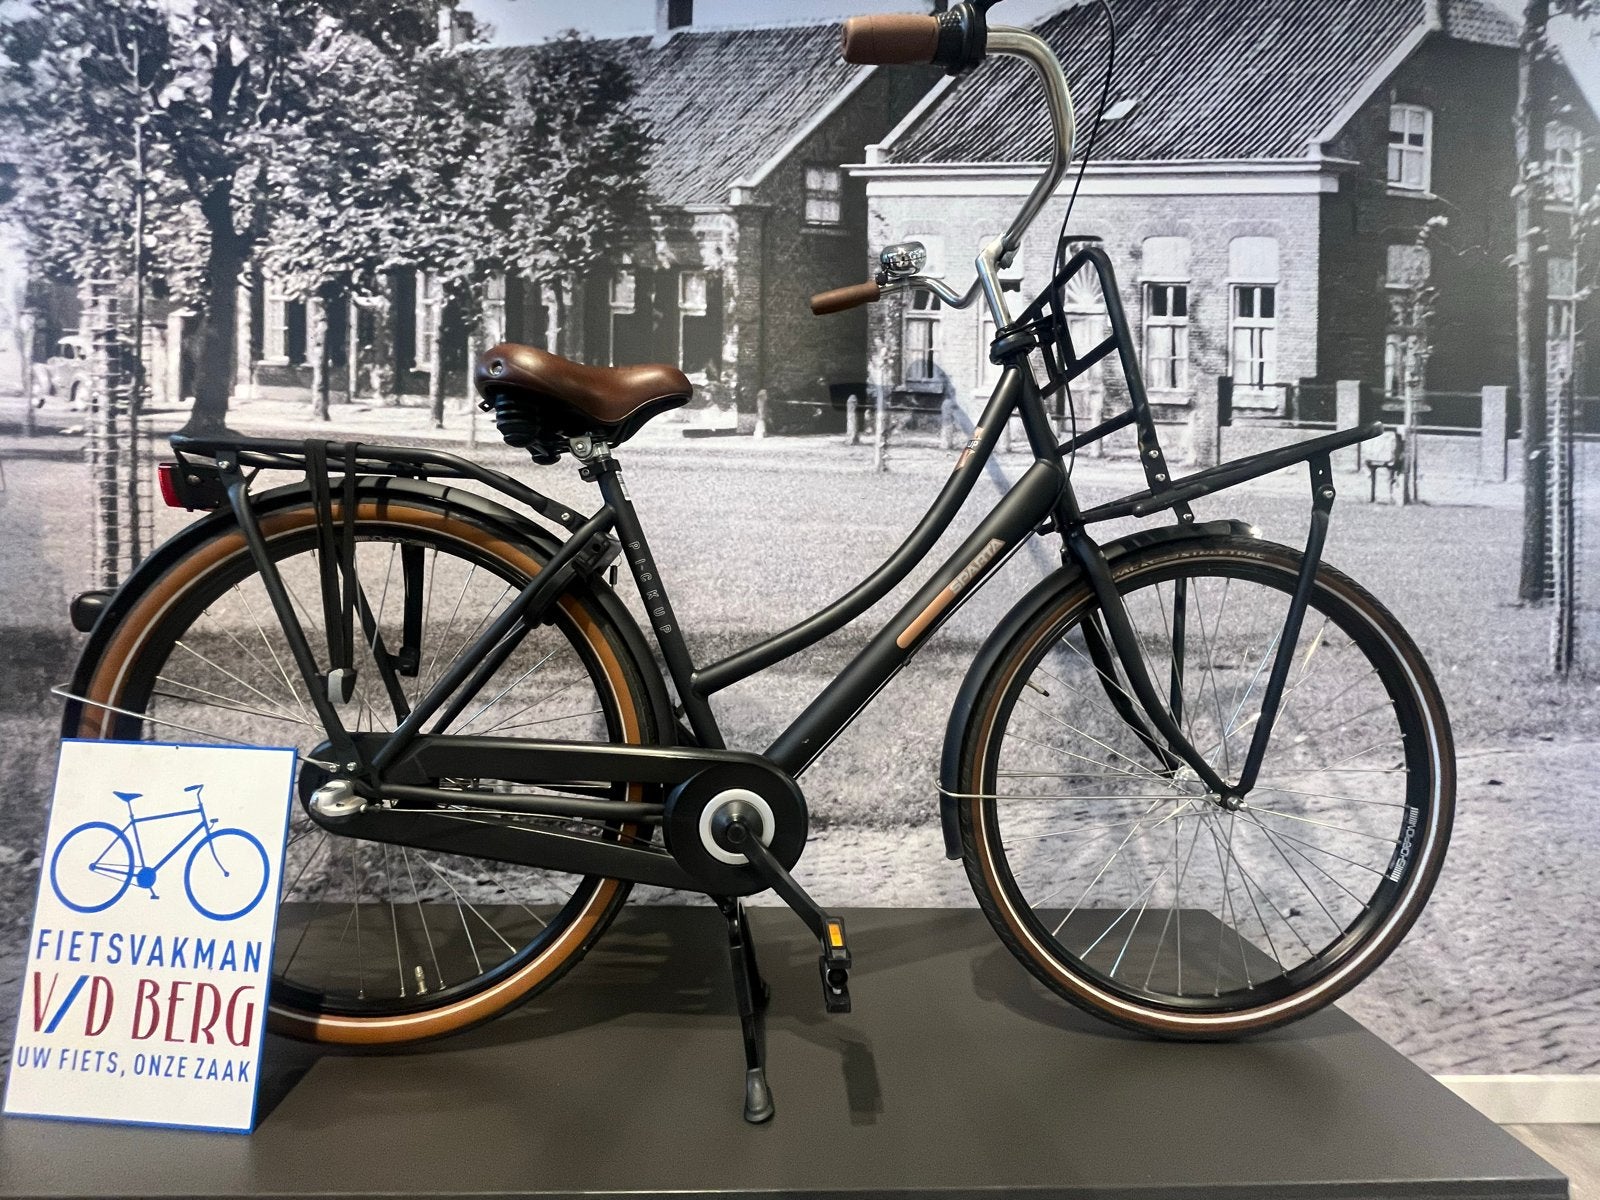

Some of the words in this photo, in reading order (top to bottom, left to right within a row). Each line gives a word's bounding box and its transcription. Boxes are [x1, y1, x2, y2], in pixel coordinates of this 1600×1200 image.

[951, 539, 1004, 594] SPARTA
[36, 929, 262, 973] FIETSVAKMAN
[34, 971, 114, 1037] V/D
[131, 978, 256, 1047] BERG
[17, 1046, 52, 1068] UW
[59, 1048, 126, 1078] FIETS,
[134, 1053, 188, 1078] ONZE
[194, 1057, 250, 1083] ZAAK
